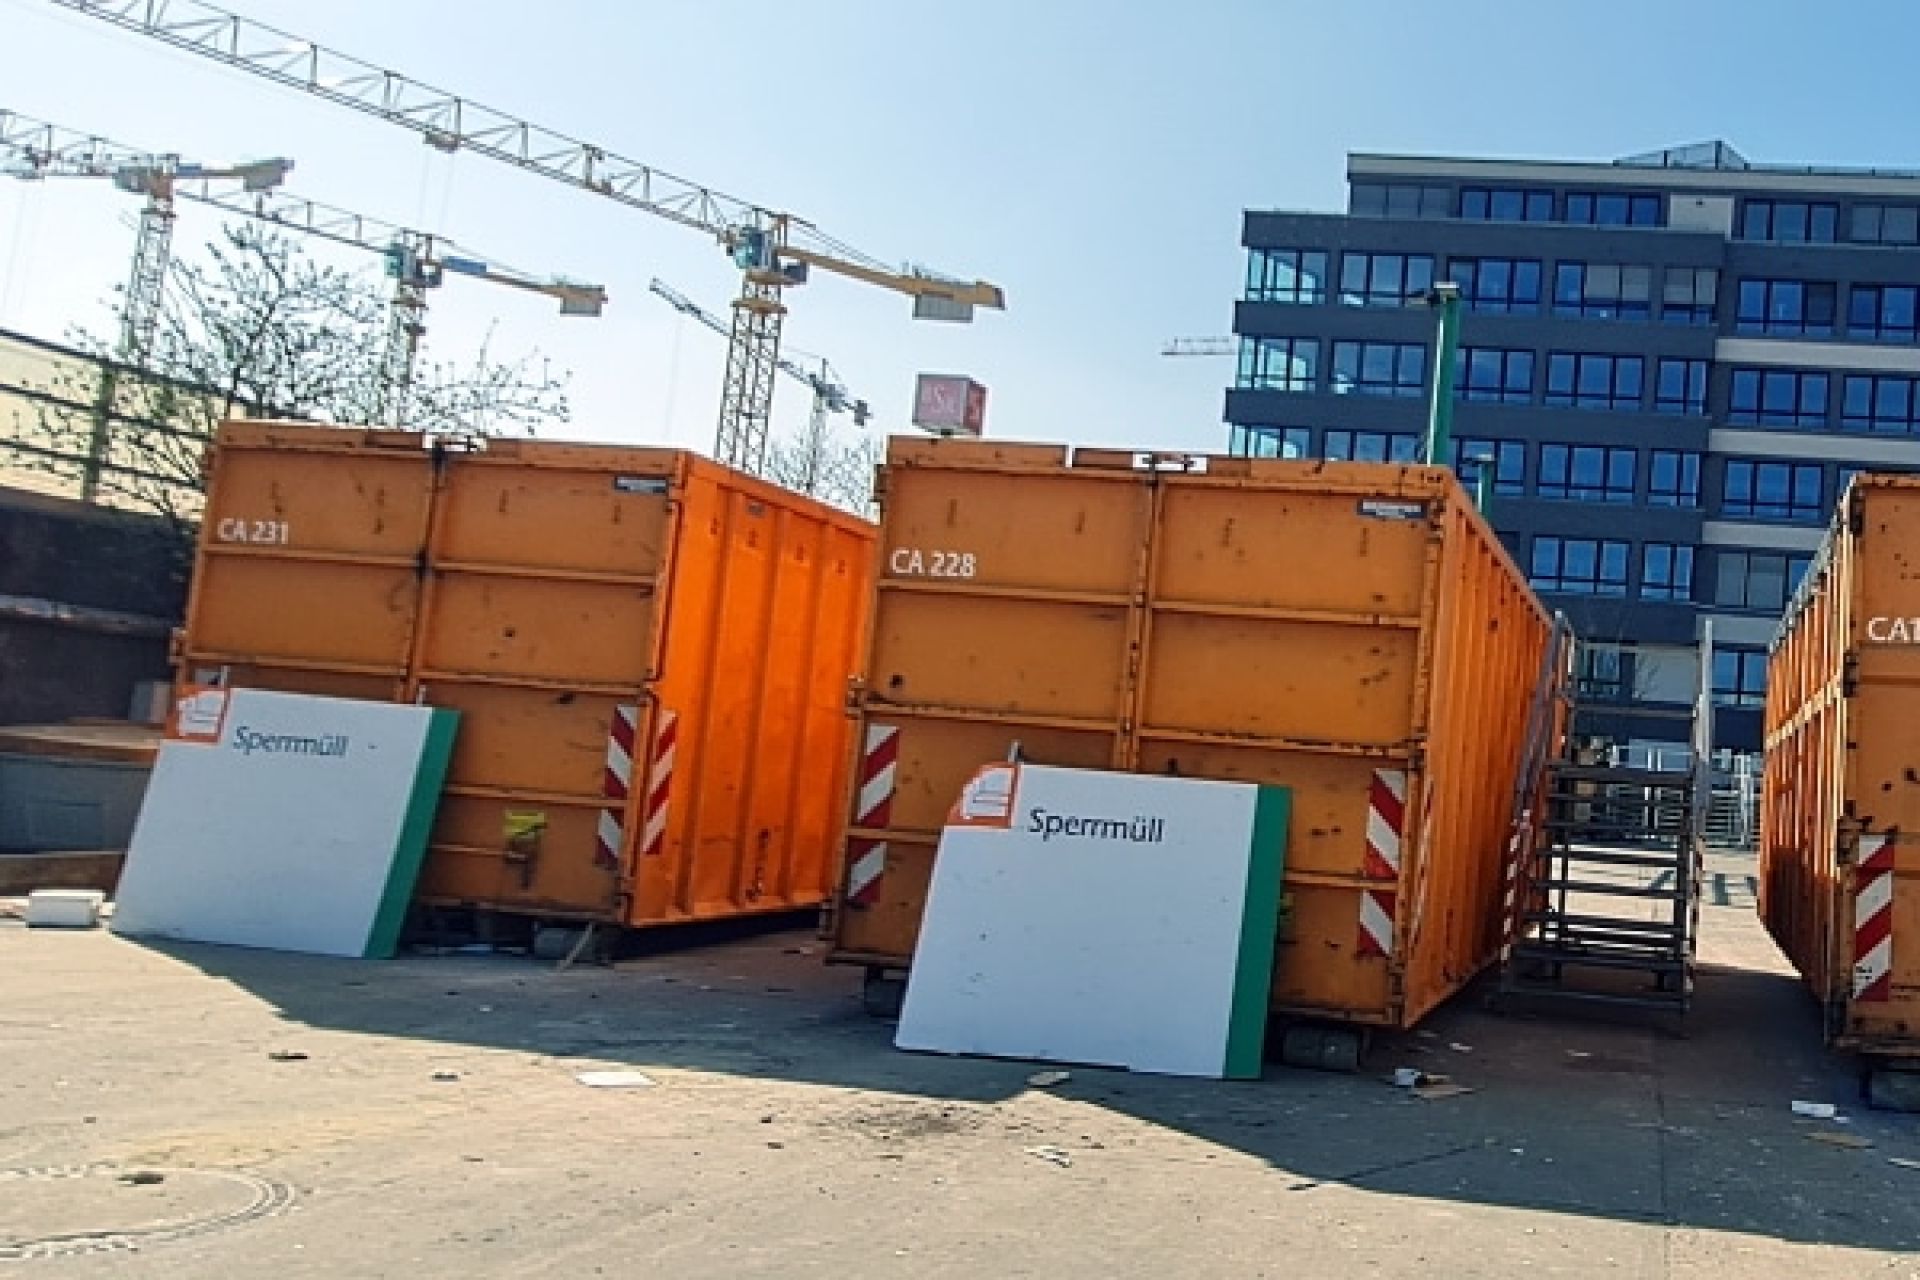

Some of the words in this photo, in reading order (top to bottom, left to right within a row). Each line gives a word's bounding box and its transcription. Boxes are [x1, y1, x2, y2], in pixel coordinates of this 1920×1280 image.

[217, 517, 247, 541] CA
[252, 520, 289, 545] 231
[890, 548, 923, 574] CA
[929, 551, 977, 578] 228
[233, 724, 350, 758] Sperrmüll
[1028, 805, 1165, 842] Sperrmüll
